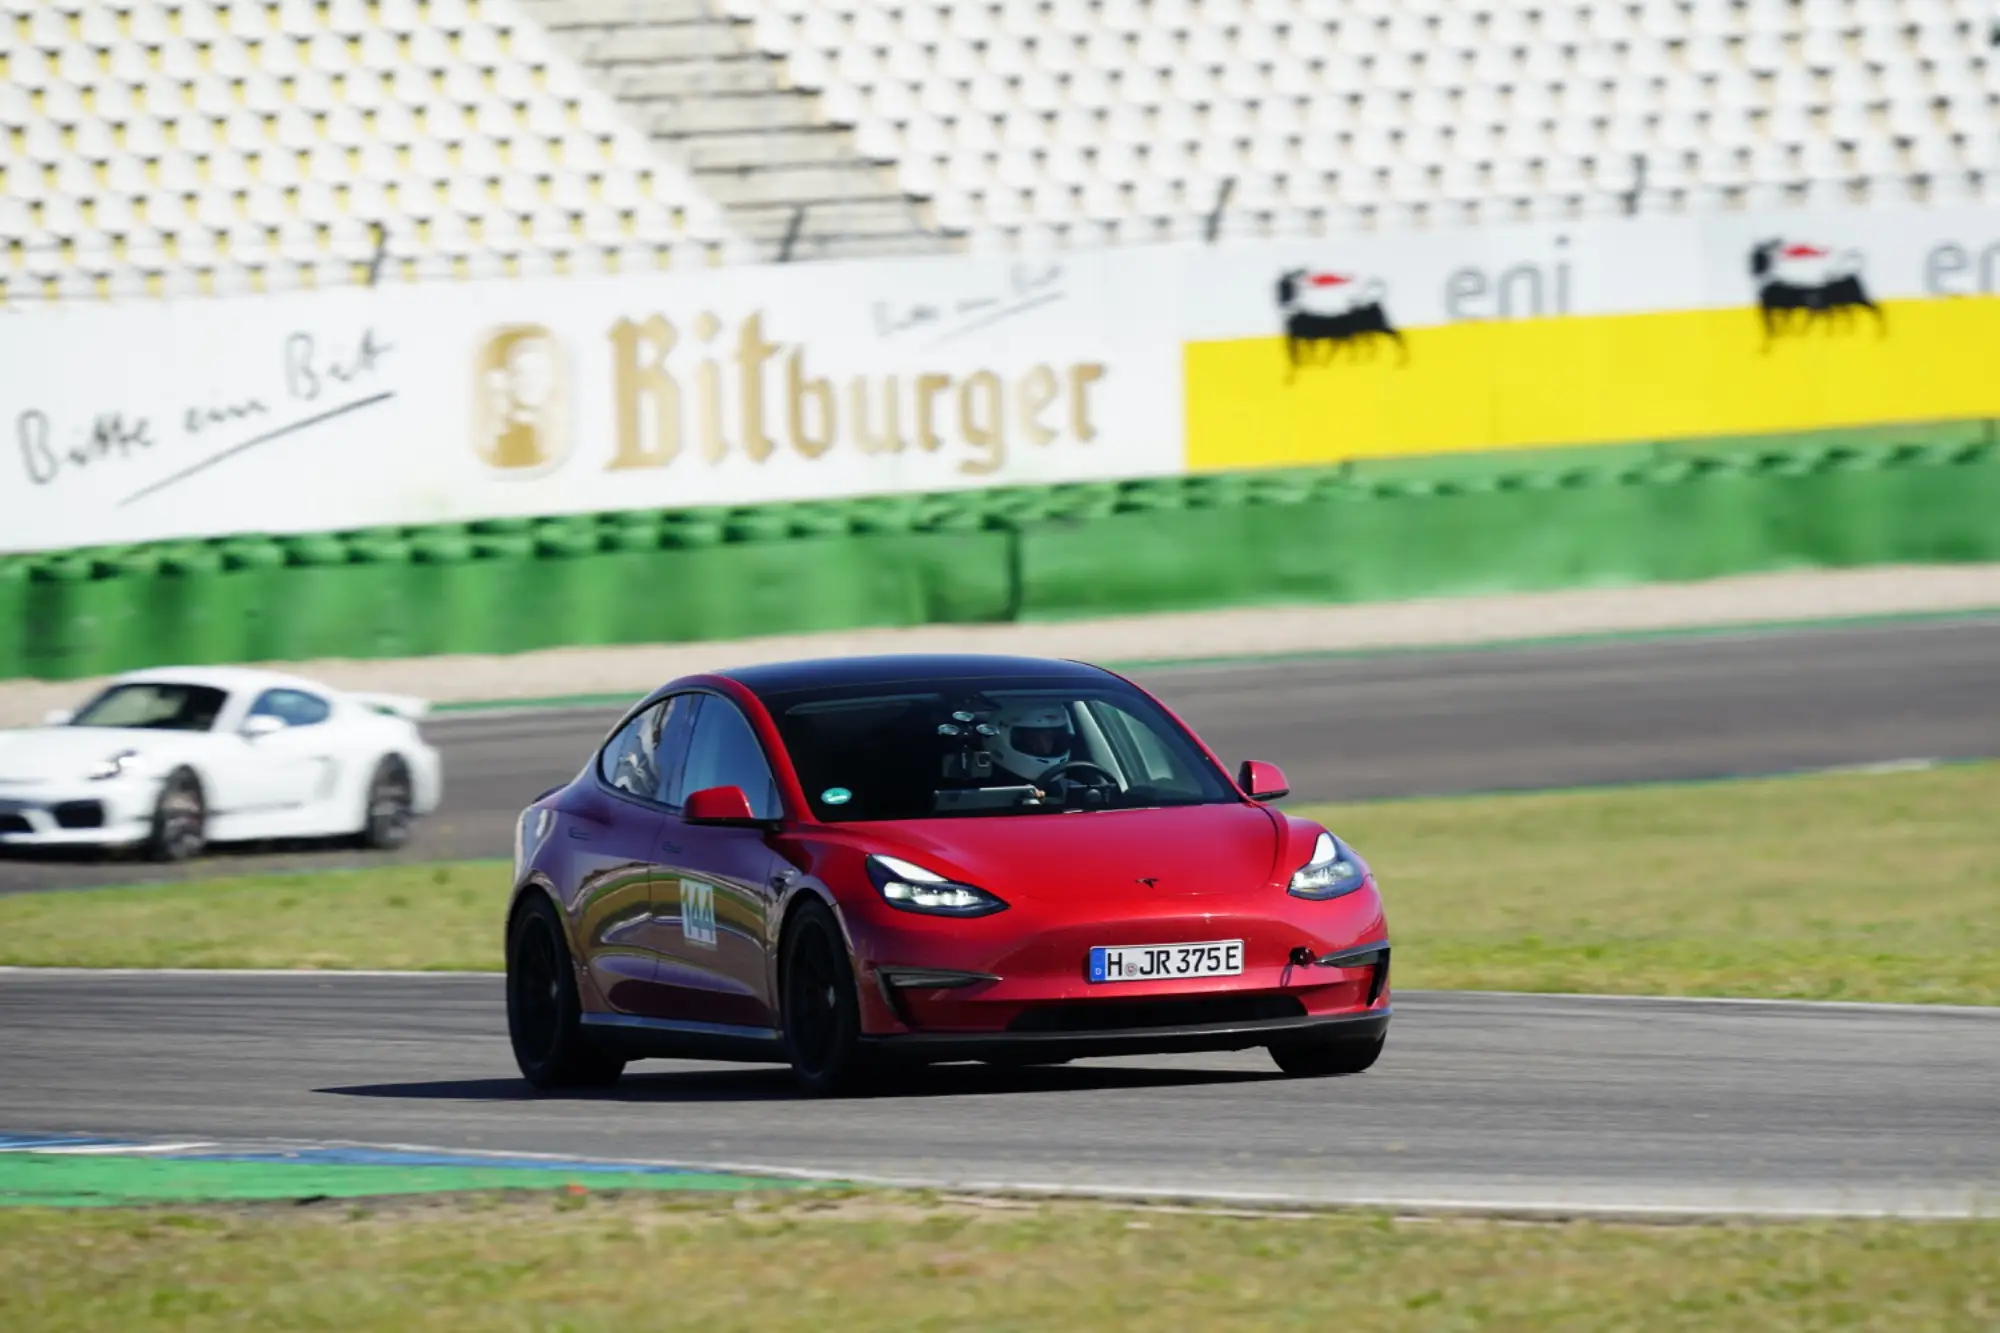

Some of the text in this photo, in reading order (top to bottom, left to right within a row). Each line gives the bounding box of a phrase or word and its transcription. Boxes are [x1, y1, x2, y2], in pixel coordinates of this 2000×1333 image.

[1444, 232, 1573, 323] eni
[15, 408, 156, 484] Bitte
[281, 325, 398, 402] Bit
[602, 309, 1109, 476] Bitburger
[680, 884, 714, 942] 144
[1107, 952, 1122, 977] H
[1139, 950, 1170, 976] JR
